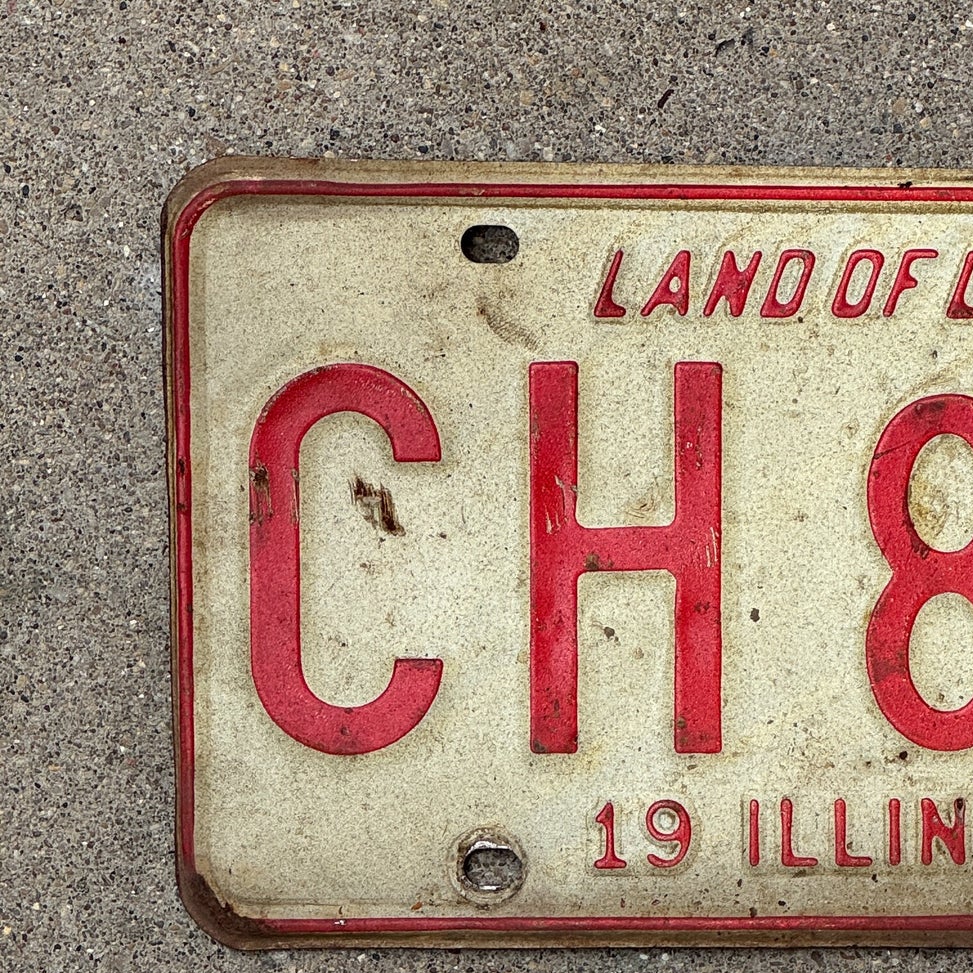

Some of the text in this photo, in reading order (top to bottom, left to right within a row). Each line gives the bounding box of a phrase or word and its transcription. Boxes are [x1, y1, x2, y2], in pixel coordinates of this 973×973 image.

[593, 248, 816, 319] LAND
[830, 248, 939, 319] OF
[248, 360, 724, 756] CH
[594, 799, 692, 870] 19
